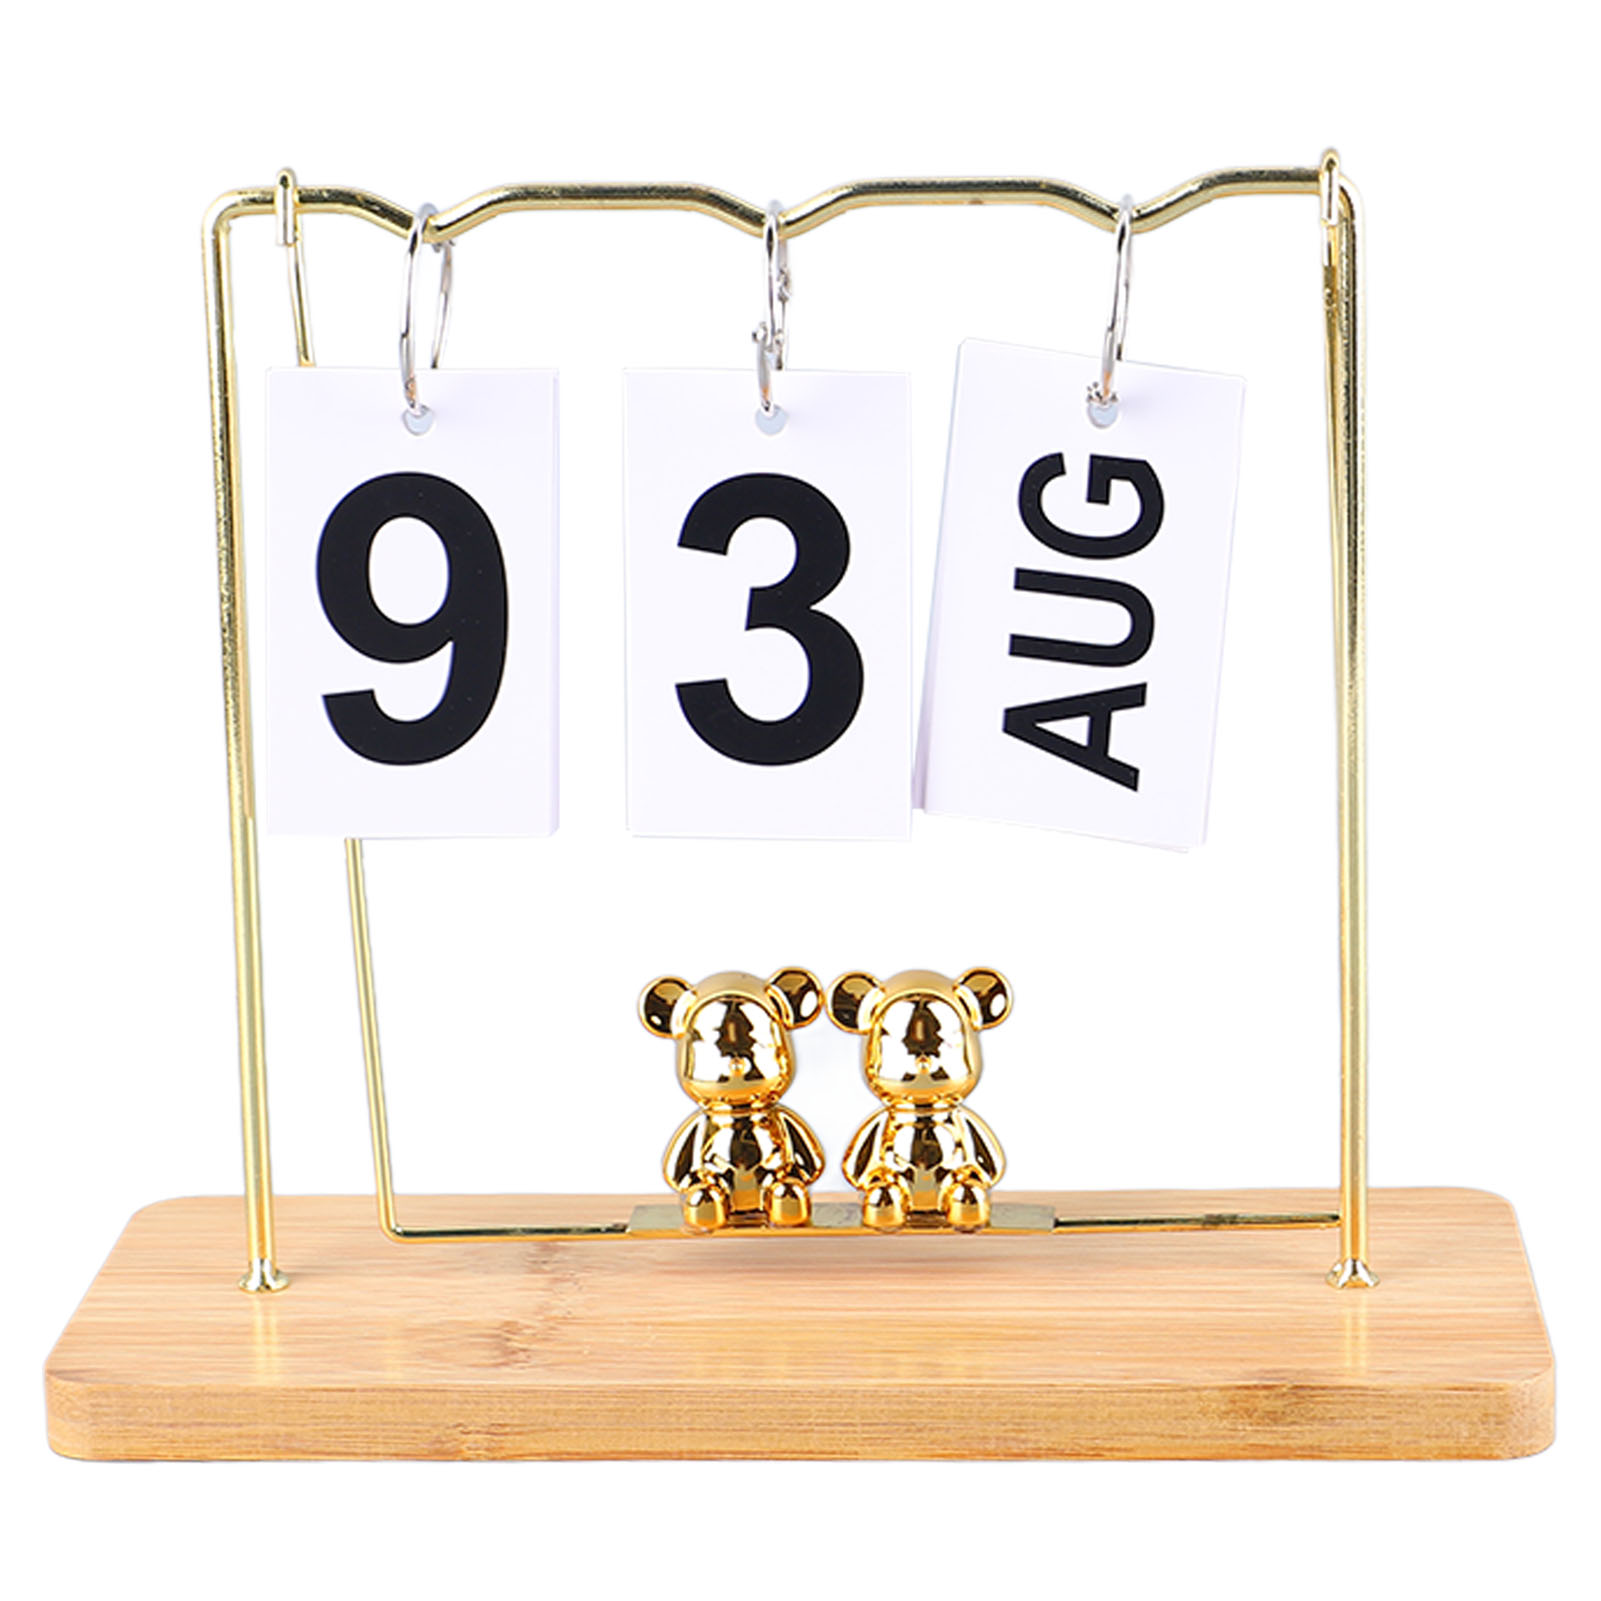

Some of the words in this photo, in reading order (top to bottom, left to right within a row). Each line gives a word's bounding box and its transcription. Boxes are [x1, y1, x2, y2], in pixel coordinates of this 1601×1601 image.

[316, 471, 509, 766] 9
[675, 472, 864, 767] 3
[1002, 452, 1165, 792] AUG
